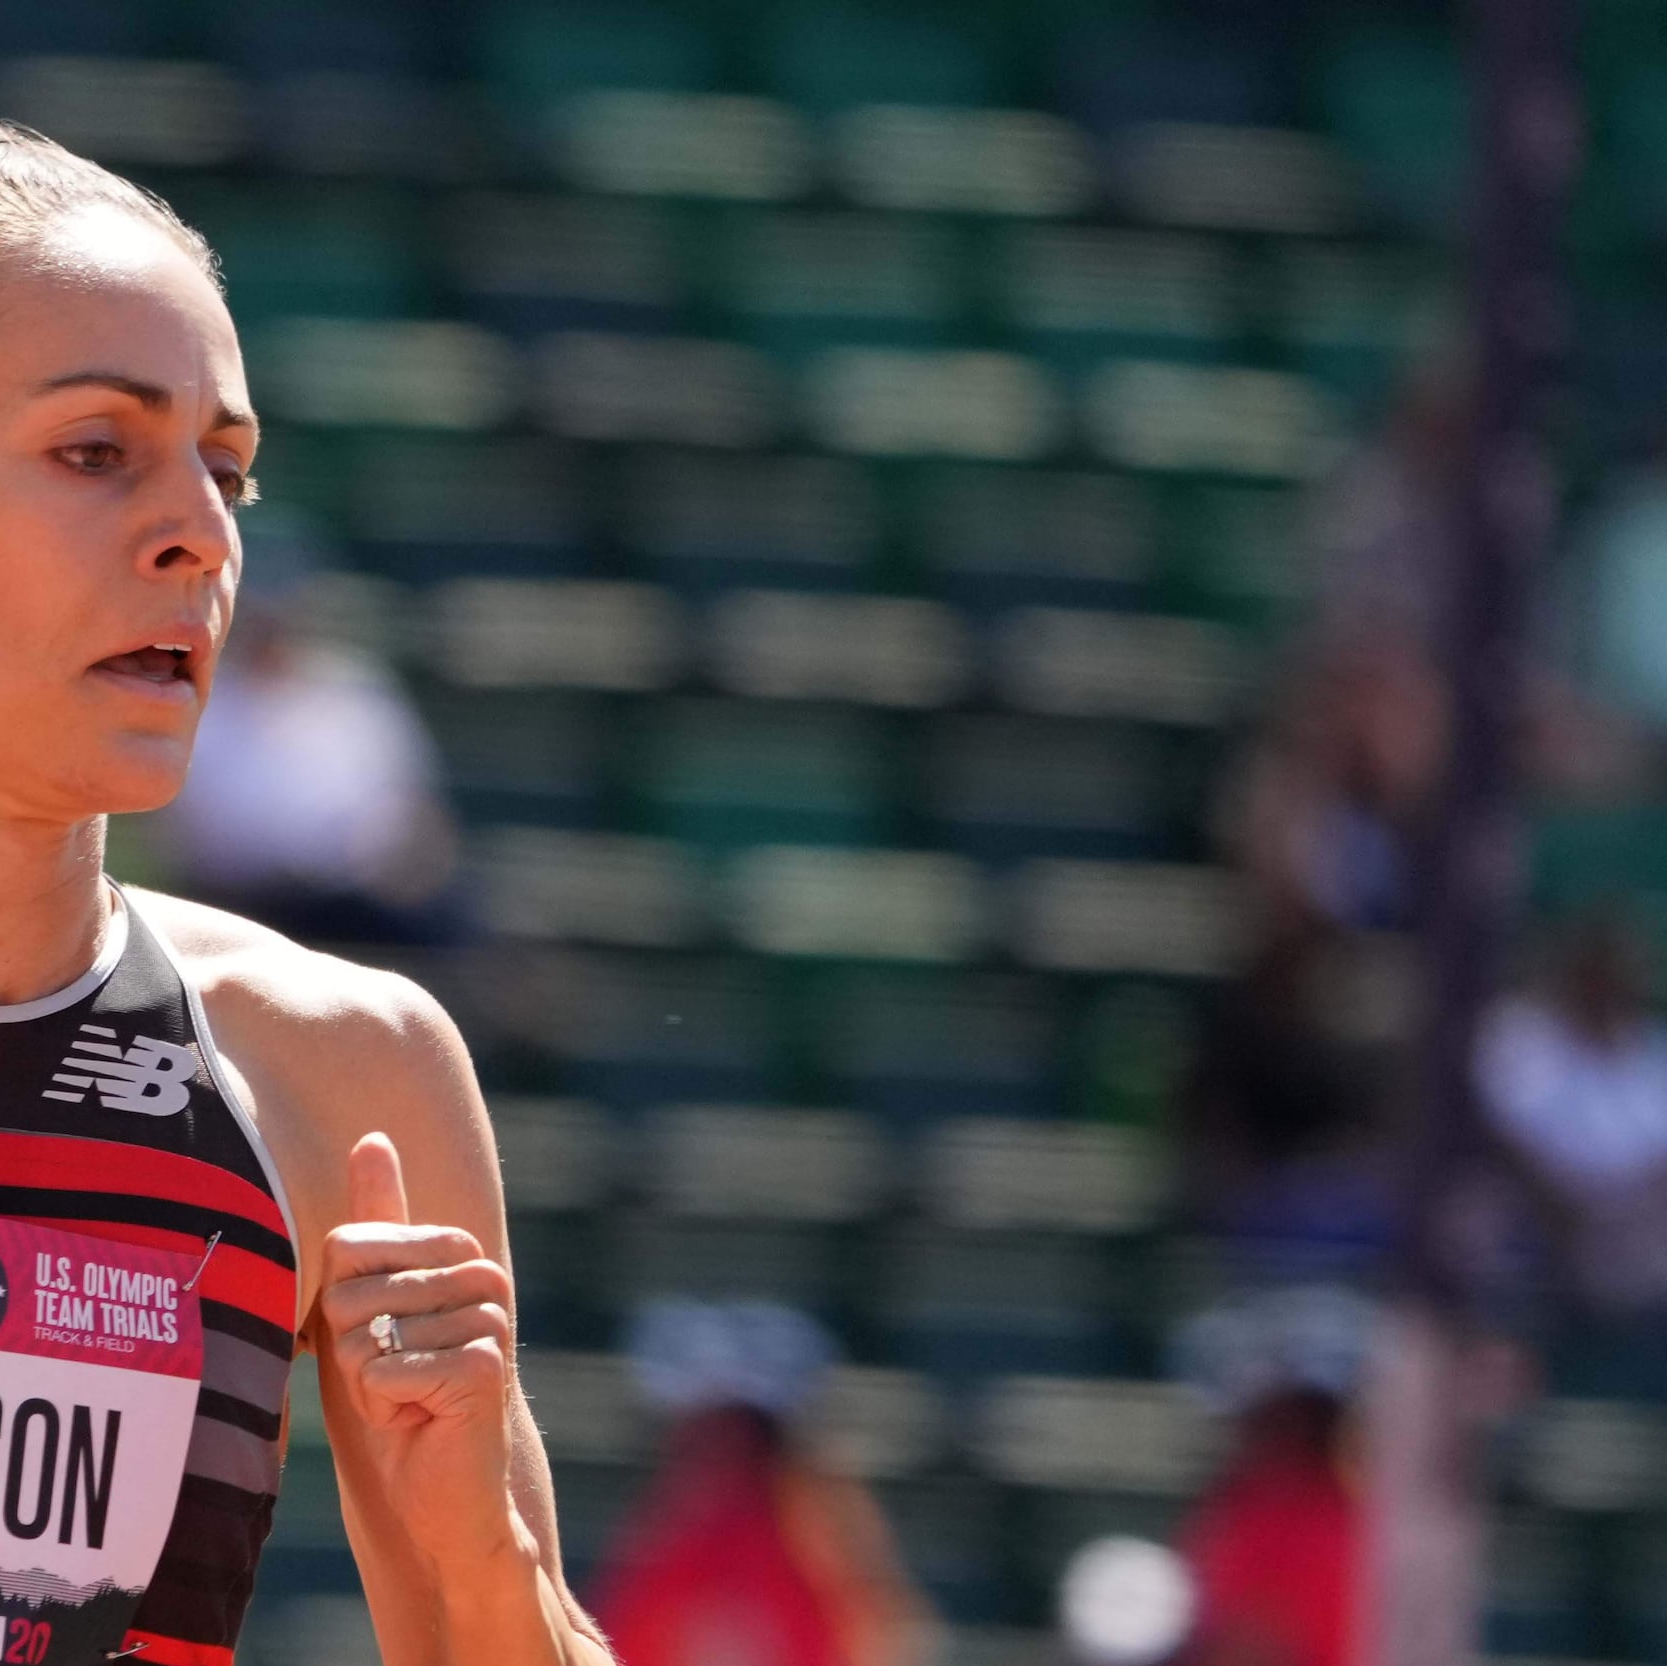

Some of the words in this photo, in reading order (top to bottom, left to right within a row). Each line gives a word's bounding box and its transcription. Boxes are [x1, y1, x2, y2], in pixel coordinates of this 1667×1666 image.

[35, 1252, 76, 1292] U.S.
[83, 1262, 178, 1311] OLYMPIC
[33, 1326, 81, 1345] TRACK
[82, 1335, 94, 1348] &
[96, 1335, 135, 1353] FIELD
[34, 1289, 95, 1332] TEAM
[100, 1302, 178, 1344] TRIALS
